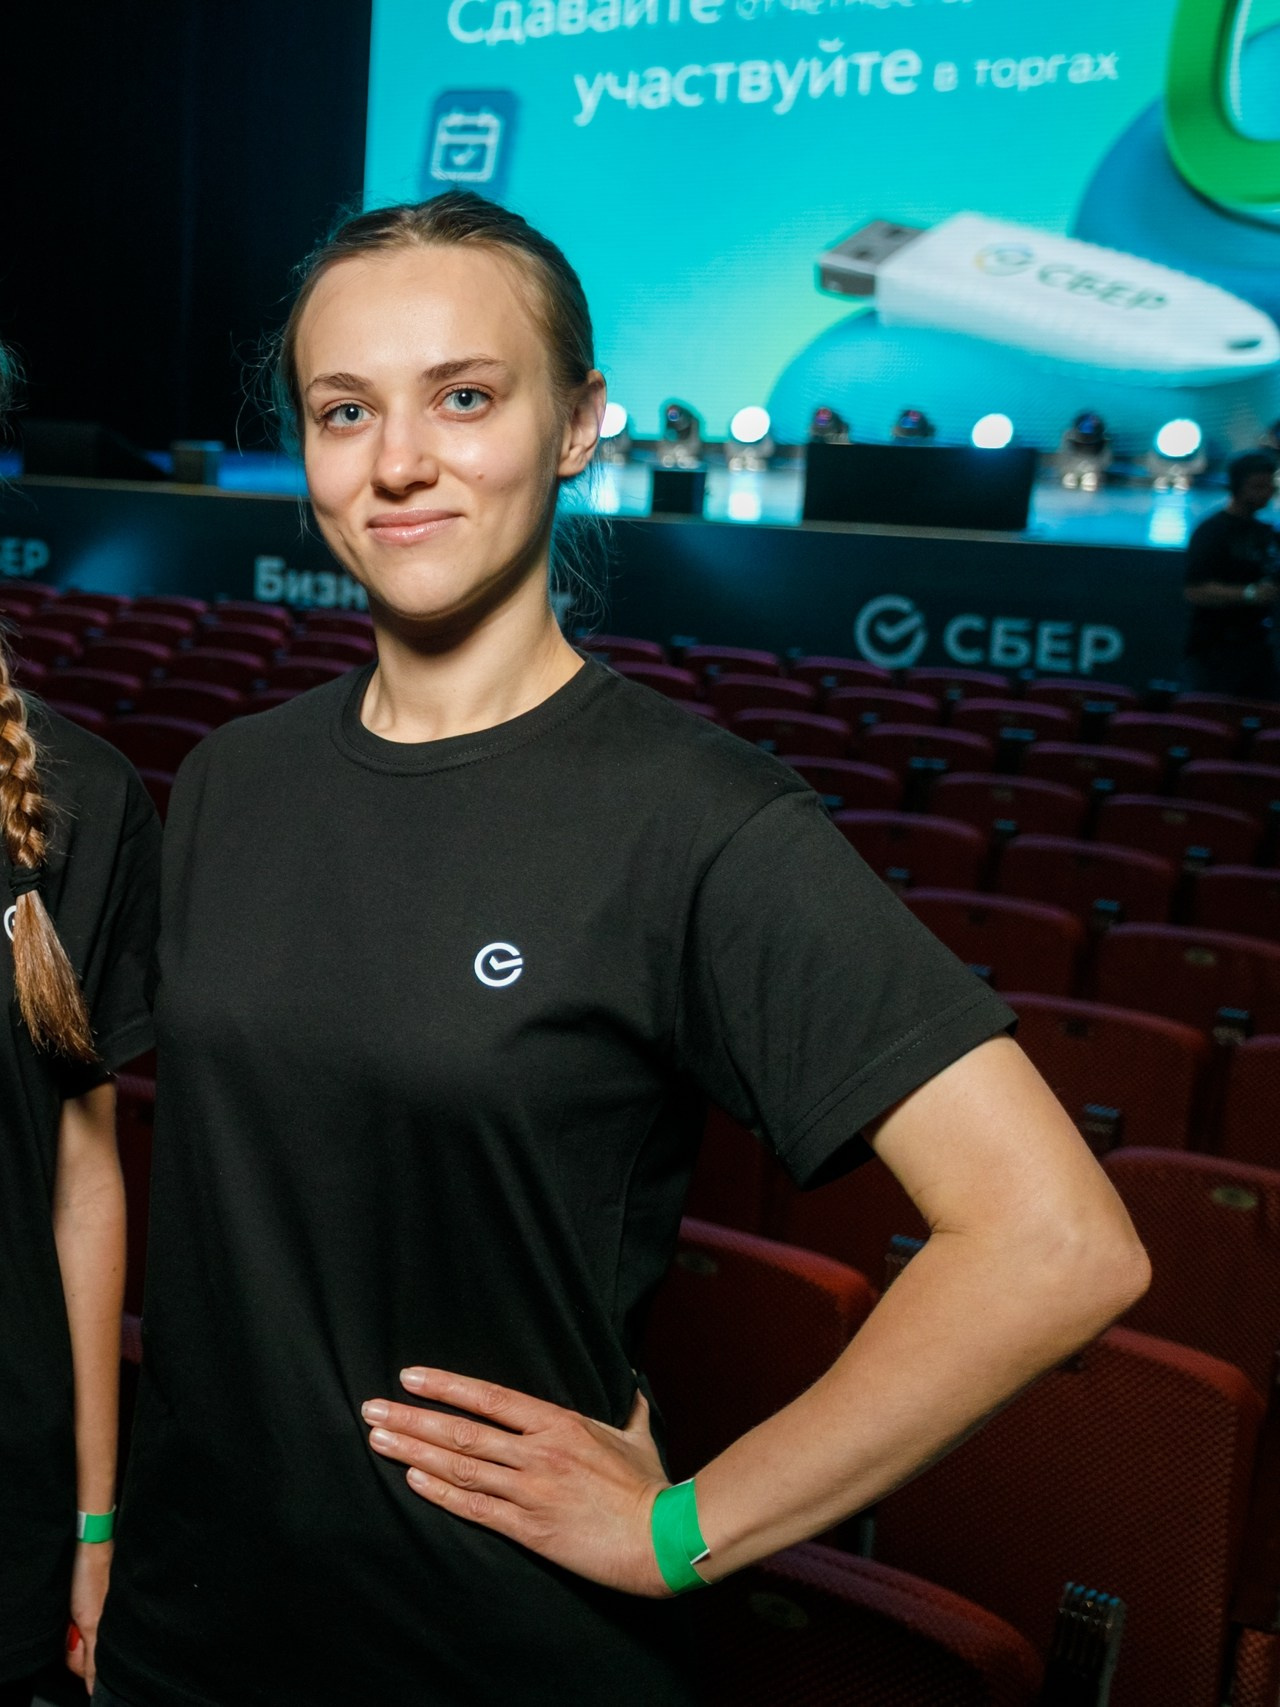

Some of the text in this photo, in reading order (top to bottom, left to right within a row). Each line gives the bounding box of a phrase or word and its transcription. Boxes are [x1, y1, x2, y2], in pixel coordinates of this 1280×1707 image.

[573, 37, 1120, 127] участвуйте в торгах
[1037, 262, 1171, 310] СБЕР
[253, 554, 370, 611] Бизн
[943, 613, 1125, 675] СБЕР
